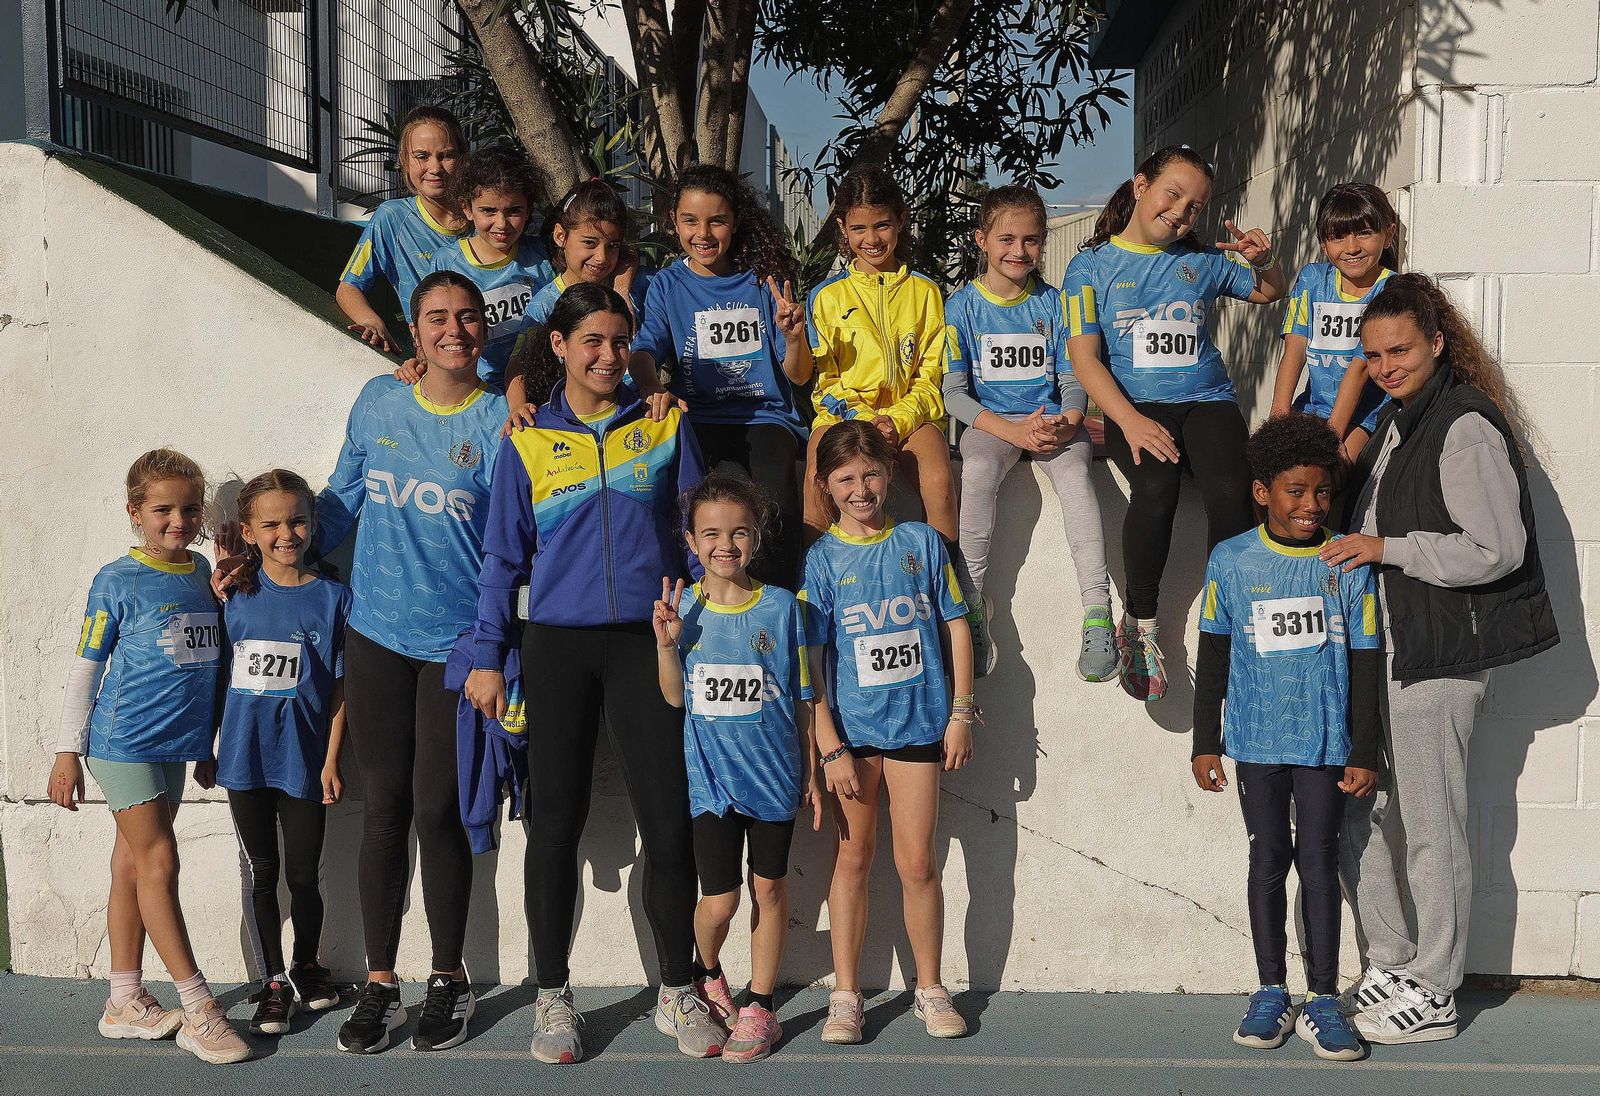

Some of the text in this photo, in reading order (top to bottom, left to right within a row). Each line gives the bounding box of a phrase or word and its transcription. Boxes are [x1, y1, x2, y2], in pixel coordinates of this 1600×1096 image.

[485, 292, 531, 327] 3246
[709, 321, 760, 345] 3261
[1321, 314, 1361, 338] 3312
[683, 335, 697, 376] CARRERA
[1145, 332, 1196, 355] 3307
[990, 346, 1045, 368] 3309
[366, 468, 476, 522] EVOS
[551, 482, 587, 497] EVOS
[840, 593, 932, 635] EVOS
[1271, 610, 1325, 637] 3311
[183, 625, 220, 650] 3270
[248, 652, 298, 679] 3271
[871, 642, 921, 672] 3251
[705, 677, 762, 702] 3242
